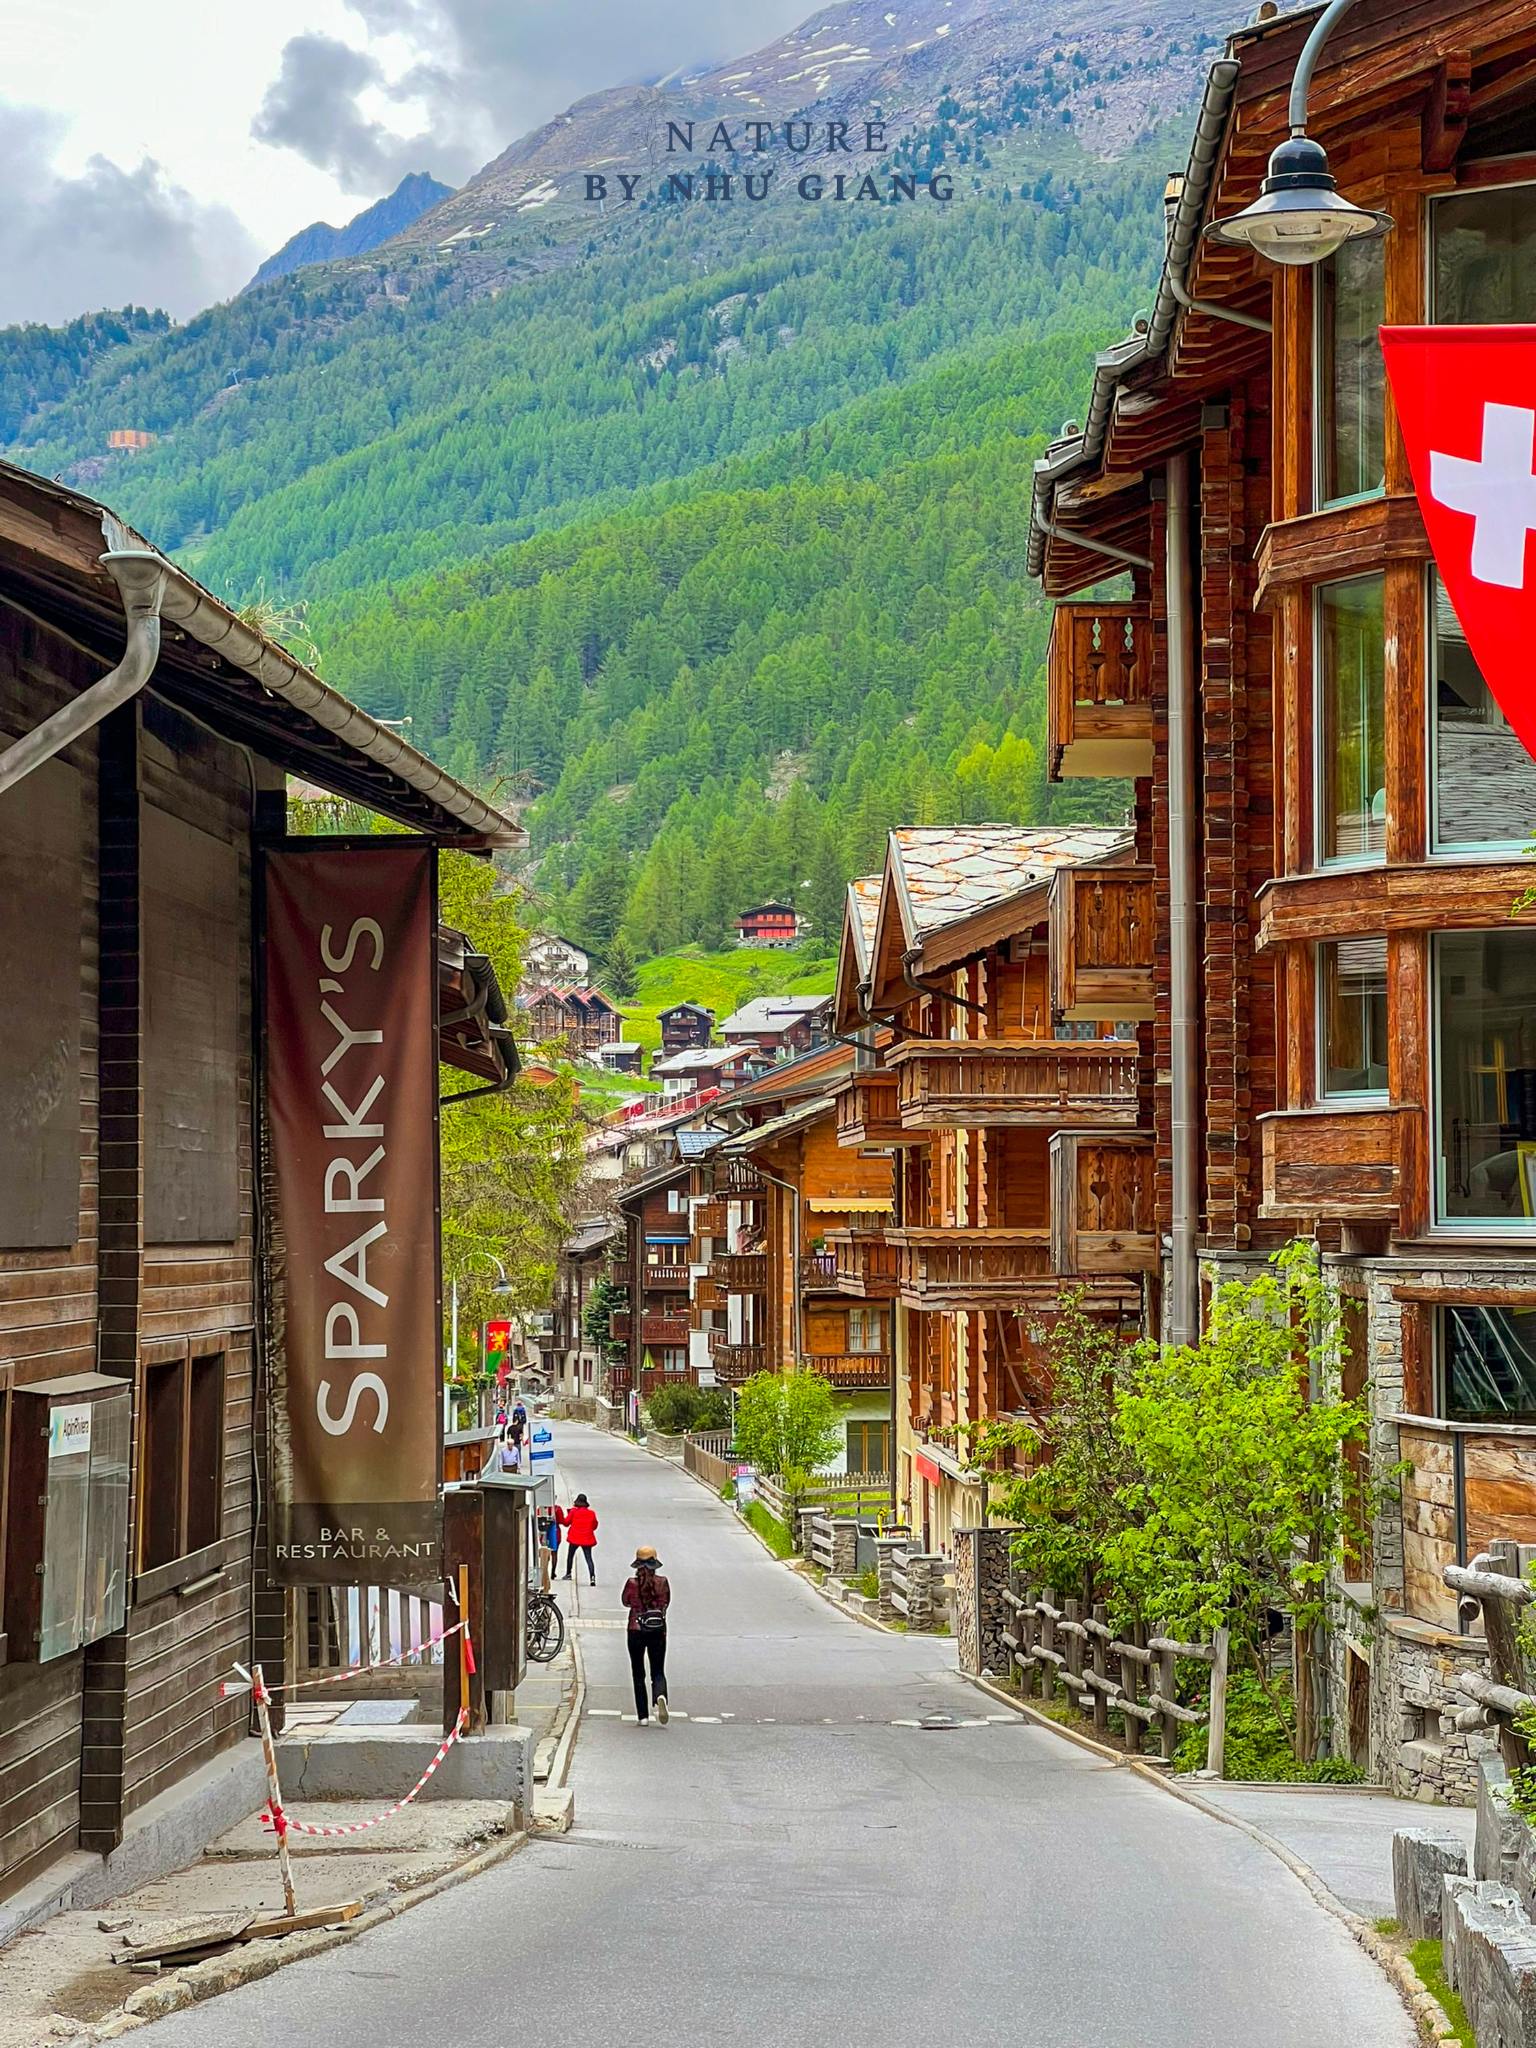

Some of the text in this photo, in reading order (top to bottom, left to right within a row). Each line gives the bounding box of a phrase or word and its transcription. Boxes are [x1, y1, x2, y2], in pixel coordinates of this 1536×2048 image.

[316, 916, 389, 1436] SPARKY'S
[320, 1527, 390, 1542] BAR &
[276, 1542, 435, 1559] RESTAURANT
